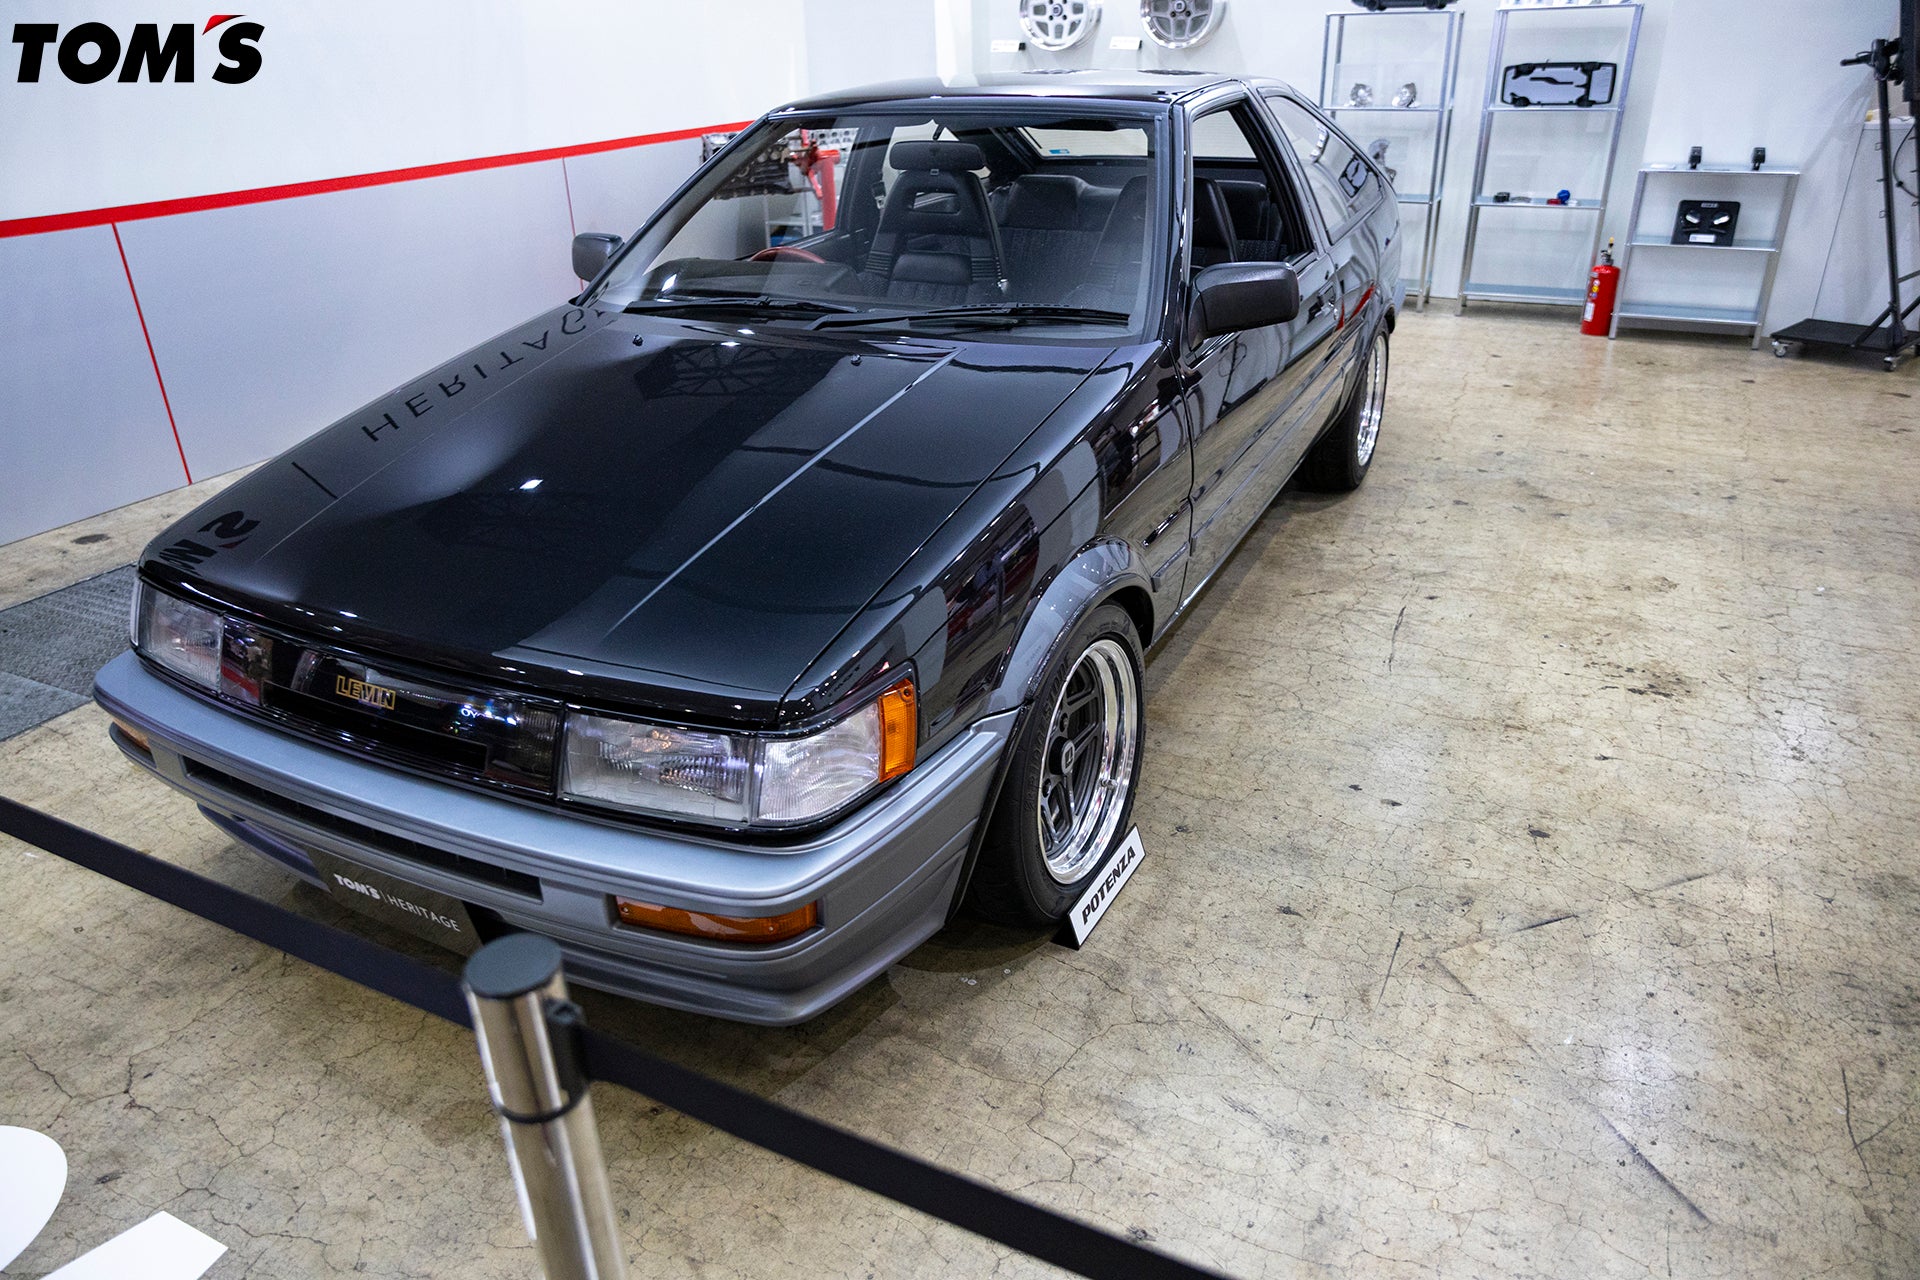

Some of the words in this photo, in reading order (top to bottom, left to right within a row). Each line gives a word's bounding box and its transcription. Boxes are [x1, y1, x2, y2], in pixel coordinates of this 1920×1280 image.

[335, 675, 396, 710] LEVIN
[333, 873, 381, 900] TOM'S
[386, 893, 462, 933] HERITAGE
[1081, 845, 1136, 926] POTENZA
